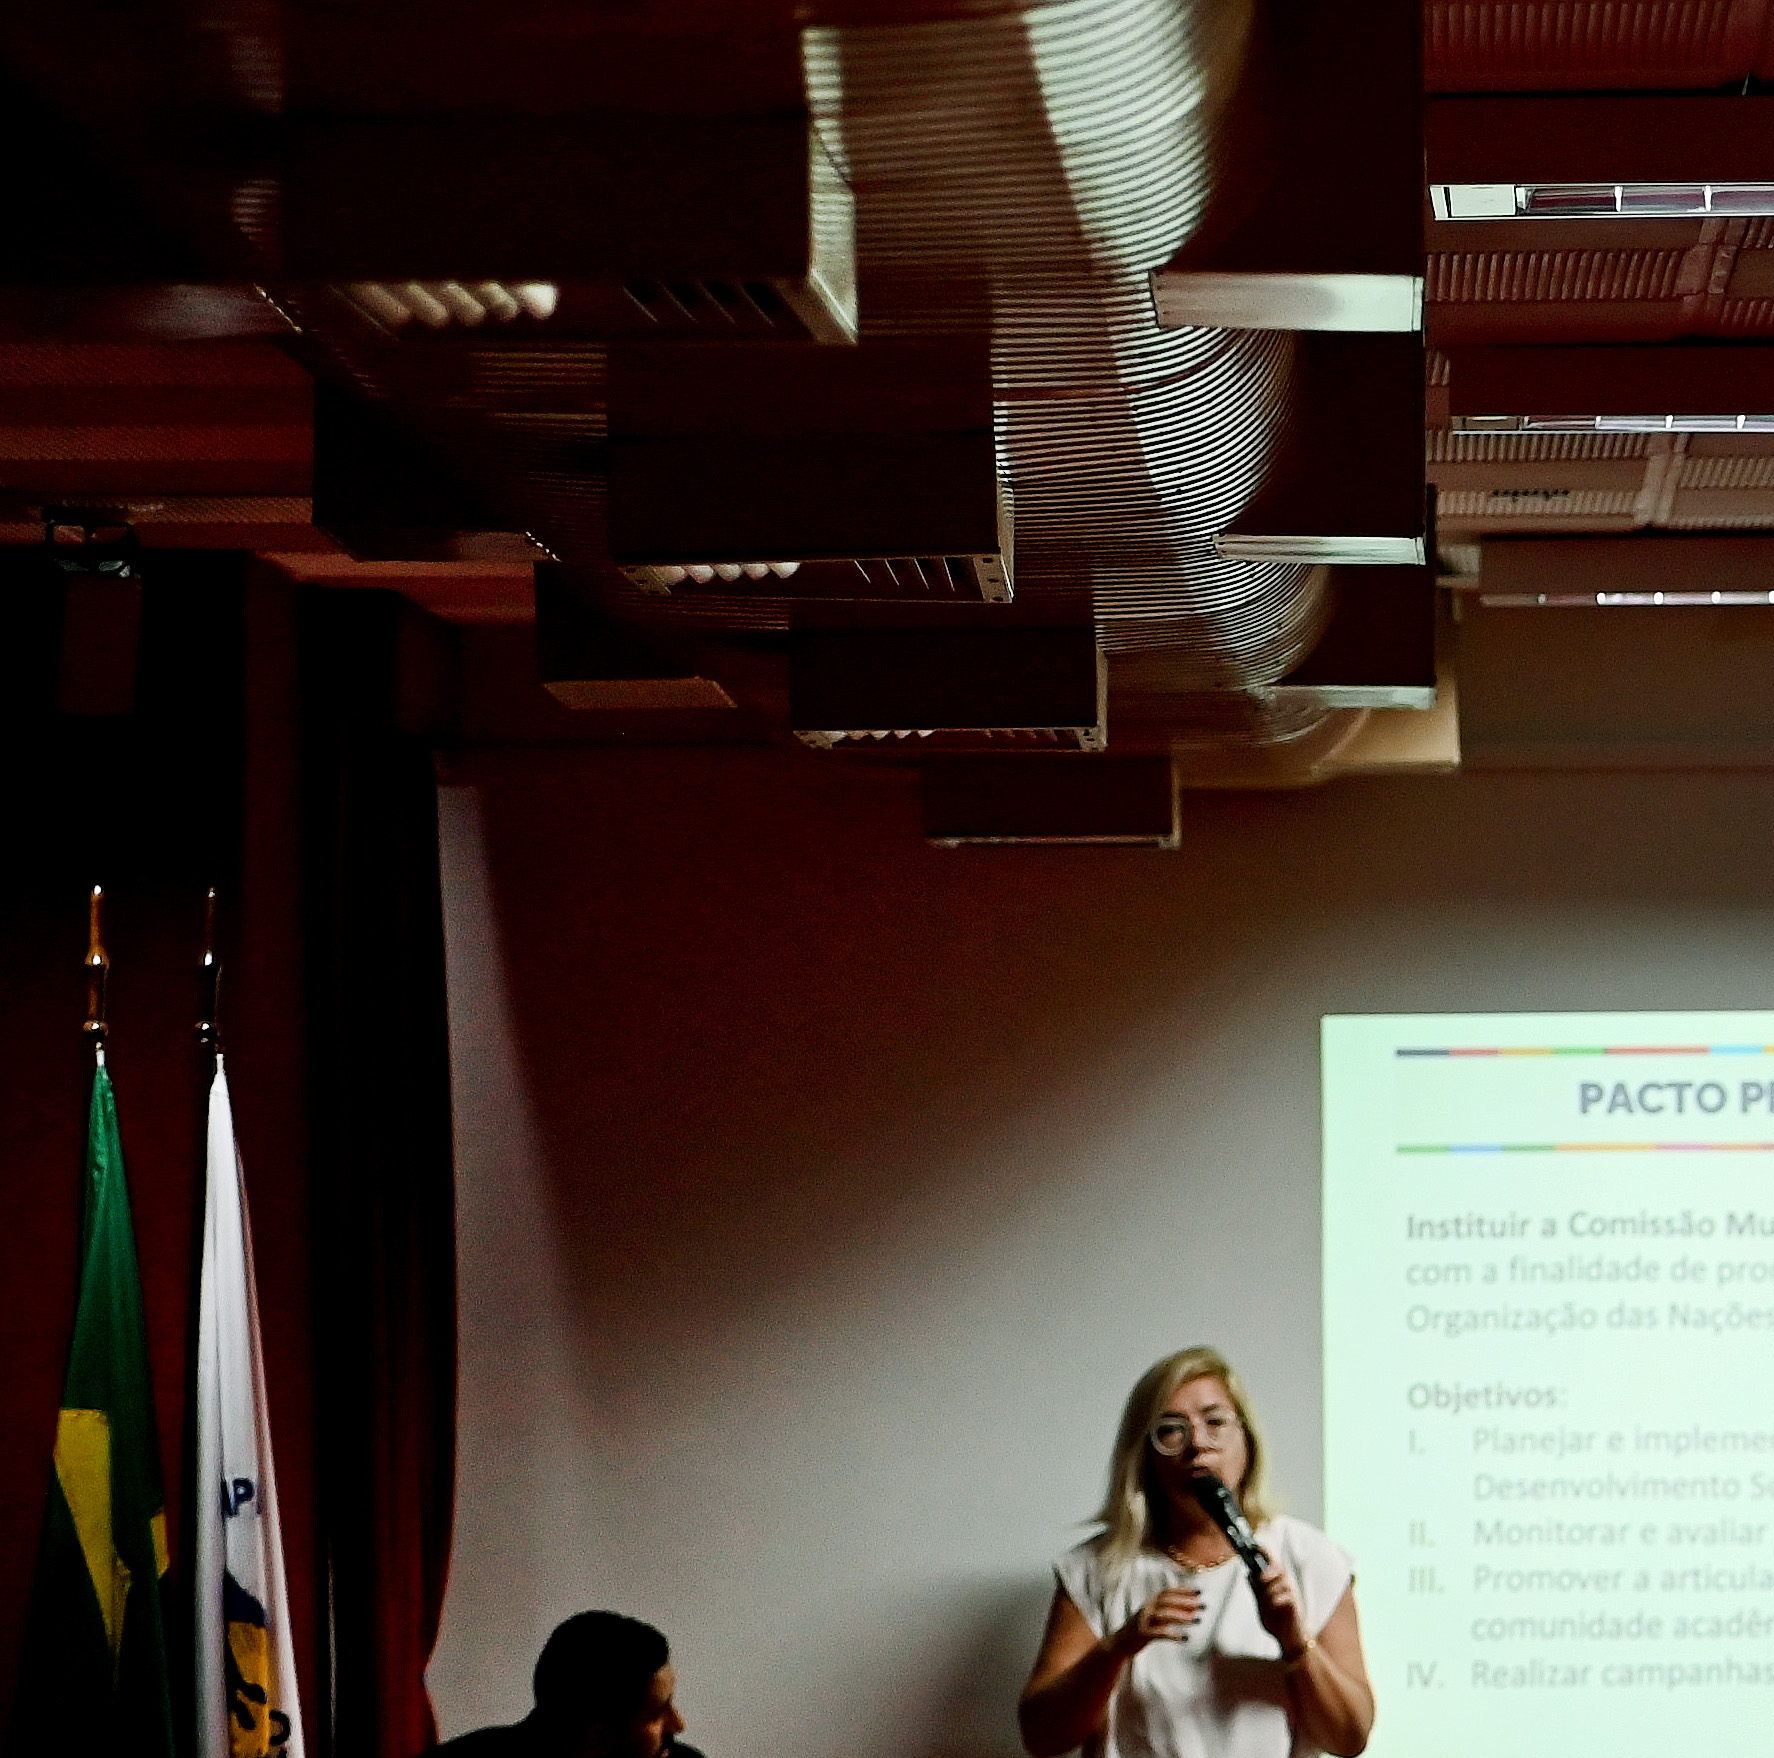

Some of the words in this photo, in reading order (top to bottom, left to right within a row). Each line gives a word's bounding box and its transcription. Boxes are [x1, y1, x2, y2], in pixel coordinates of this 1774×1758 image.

[1581, 1082, 1726, 1114] PACTO
[1409, 1214, 1528, 1238] Instituir
[1543, 1220, 1556, 1236] a
[1570, 1212, 1714, 1236] Comissão
[1408, 1265, 1471, 1284] com
[1484, 1264, 1497, 1283] a
[1510, 1256, 1660, 1282] finalidade
[1672, 1257, 1706, 1281] de
[1408, 1303, 1597, 1335] Organização
[1608, 1303, 1657, 1327] das
[1475, 1428, 1595, 1457] Planejar
[1609, 1433, 1623, 1451] e
[1476, 1474, 1740, 1499] Desenvolvimento
[1476, 1520, 1629, 1544] Monitorar
[1641, 1525, 1656, 1543] e
[1670, 1520, 1766, 1543] avaliar
[1476, 1566, 1622, 1591] Promover
[1636, 1572, 1649, 1590] a
[1472, 1612, 1662, 1640] comunidade
[1473, 1660, 1589, 1686] Realizar
